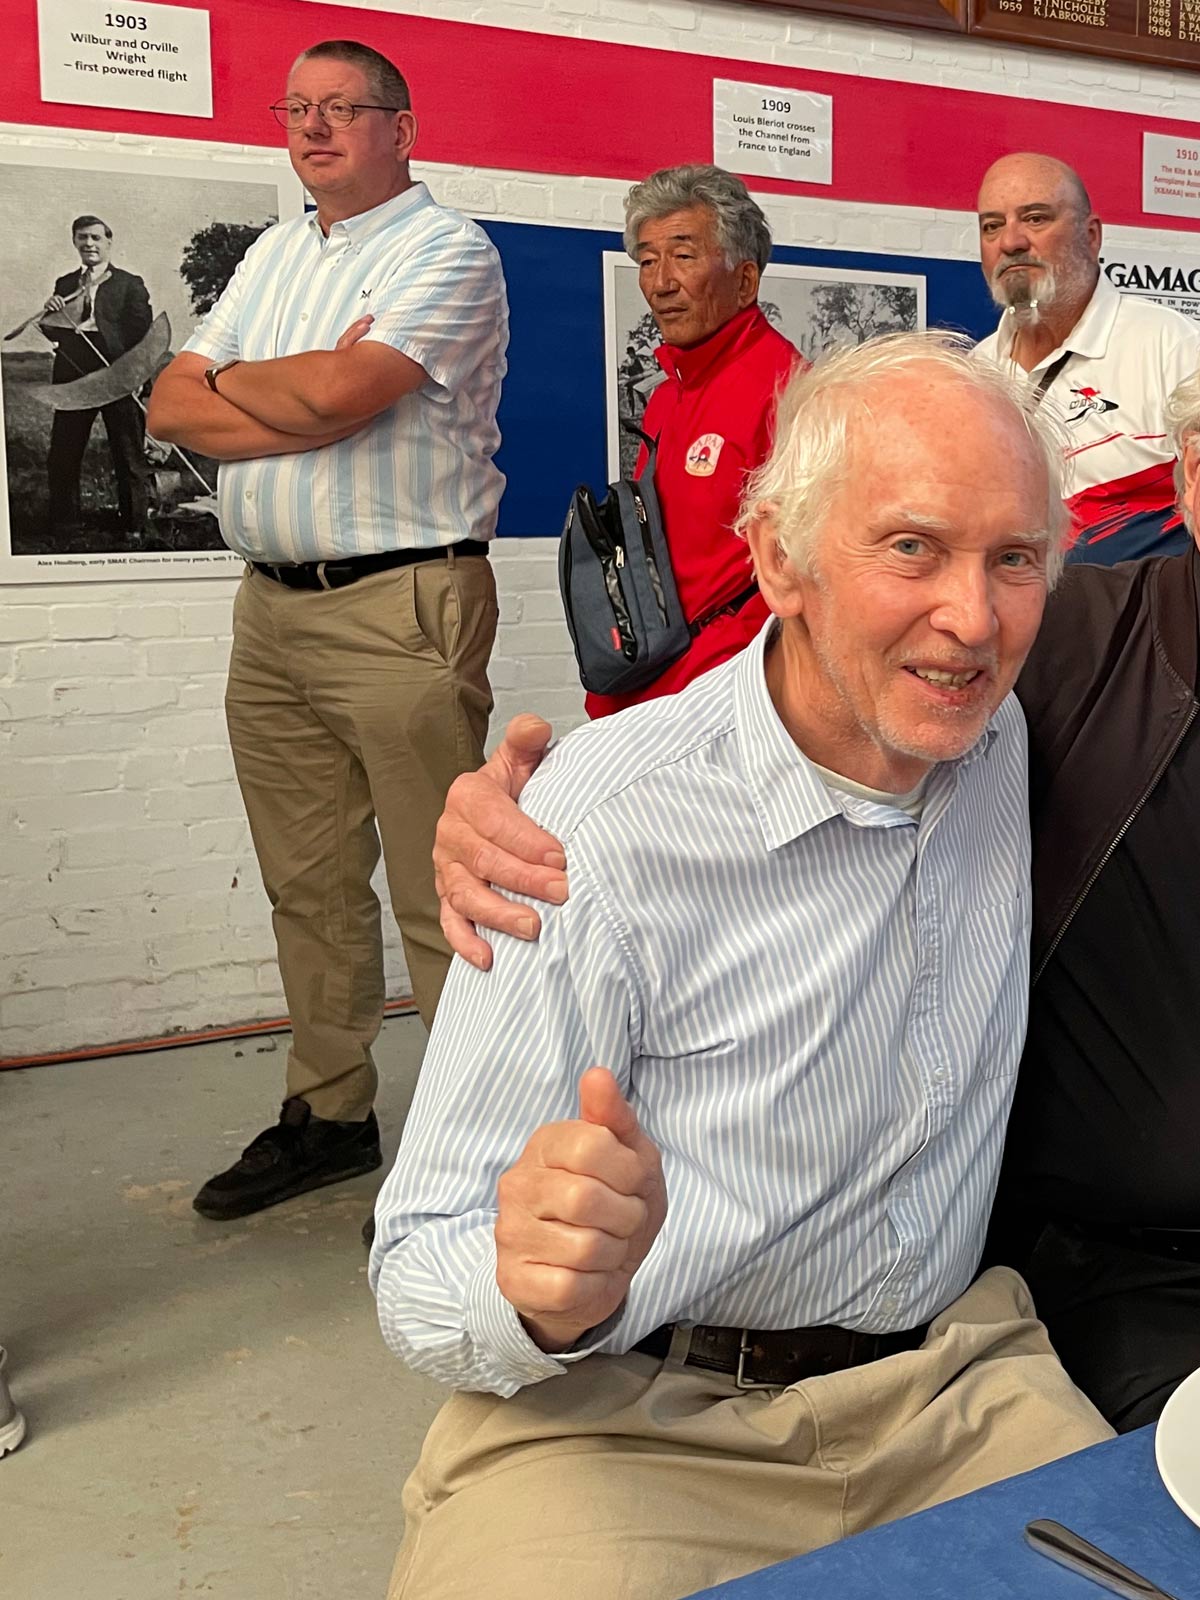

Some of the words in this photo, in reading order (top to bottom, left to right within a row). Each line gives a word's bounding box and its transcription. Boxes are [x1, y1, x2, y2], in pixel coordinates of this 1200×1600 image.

[999, 1, 1022, 13] 1959
[105, 13, 148, 31] 1903
[1148, 16, 1172, 27] 1986
[1147, 25, 1172, 38] 1986
[70, 32, 112, 46] Wilbur
[115, 37, 138, 49] and
[141, 40, 179, 54] Orville
[106, 50, 147, 65] Wright
[75, 60, 99, 73] first
[102, 64, 154, 79] powered
[157, 69, 188, 83] flight
[761, 98, 791, 113] 1909
[733, 113, 755, 125] Louis
[757, 117, 784, 128] Bleriot
[787, 122, 816, 133] crosses
[739, 128, 753, 137] the
[755, 130, 789, 141] Channel
[790, 135, 810, 144] from
[738, 140, 766, 151] France
[768, 143, 777, 152] to
[779, 145, 811, 157] England
[1176, 148, 1199, 161] 1910
[1162, 165, 1172, 174] The
